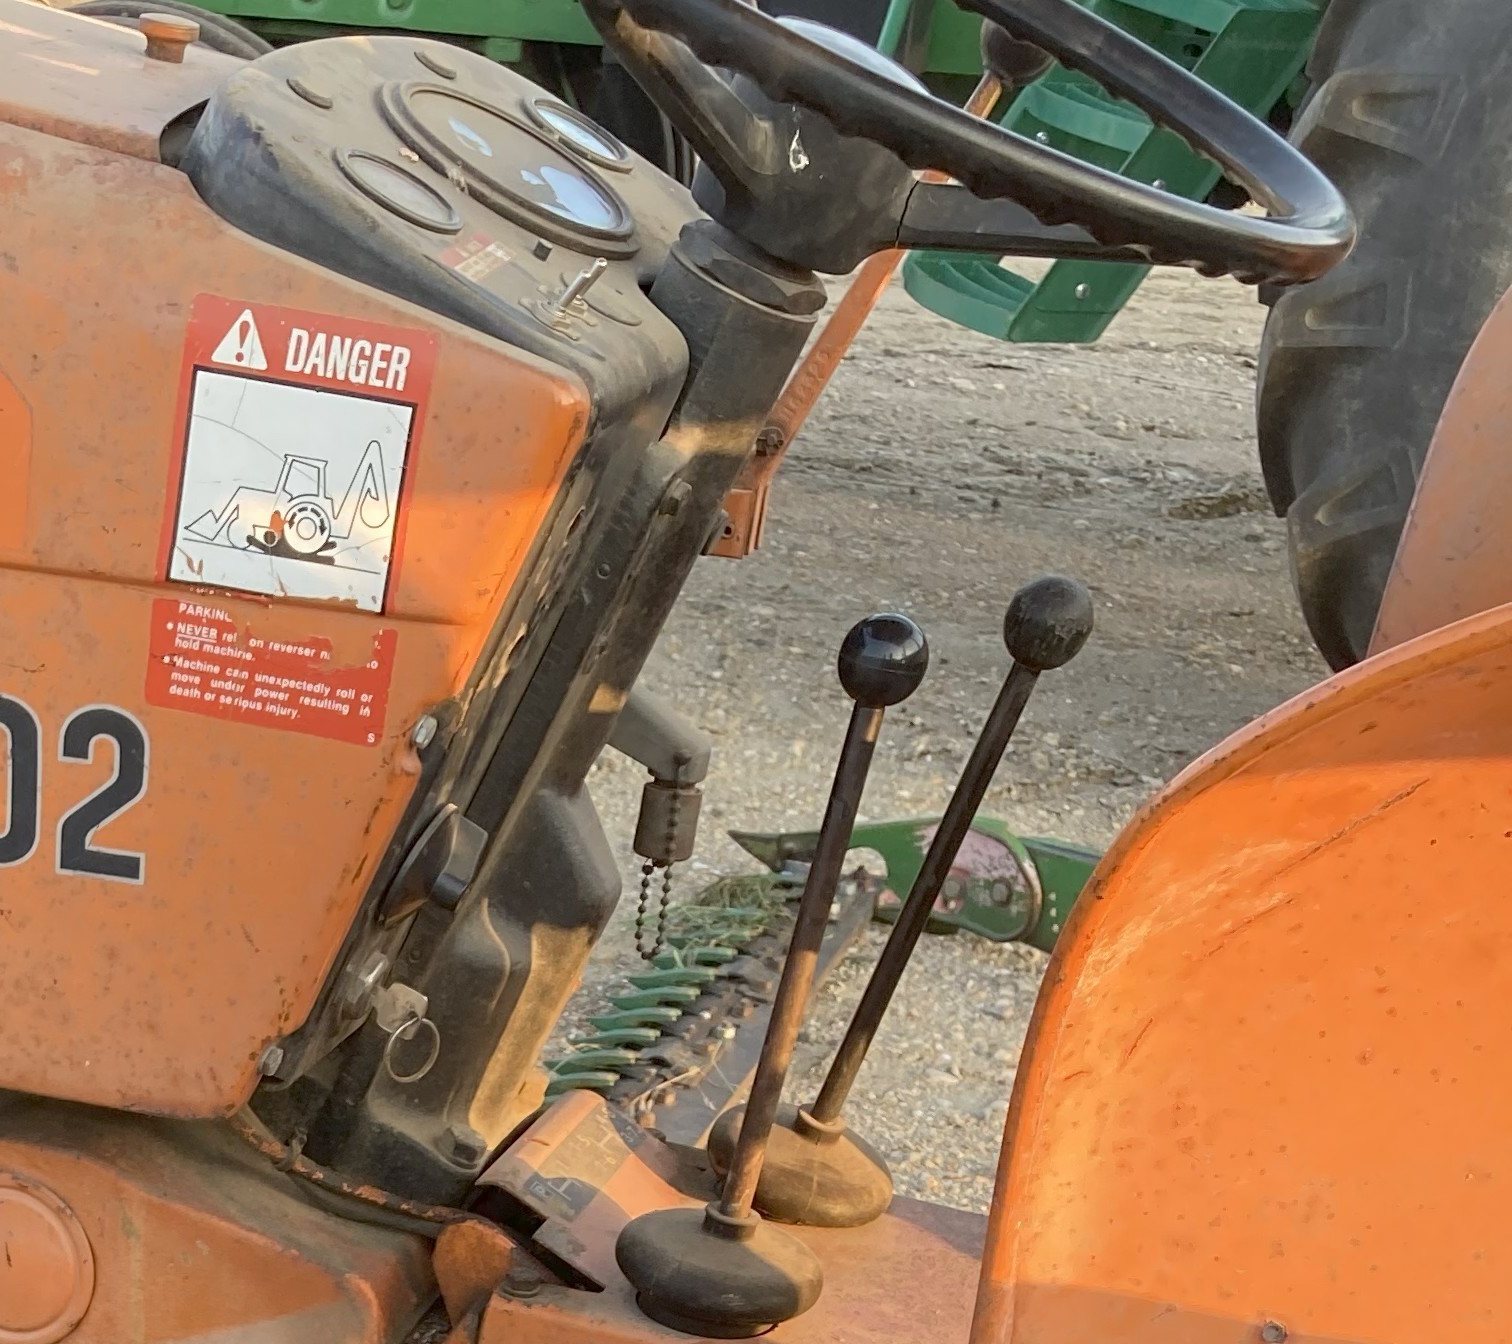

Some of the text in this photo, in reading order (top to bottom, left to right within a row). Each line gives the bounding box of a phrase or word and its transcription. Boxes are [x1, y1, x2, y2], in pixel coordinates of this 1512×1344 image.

[285, 328, 411, 391] DANGER
[174, 637, 200, 651] hold
[177, 622, 218, 642] NEVER
[249, 638, 264, 648] on
[268, 641, 316, 657] reverser
[170, 671, 370, 717] move under power resulting in
[173, 656, 373, 703] Machine can unexpectedly roll or
[169, 684, 201, 699] death
[203, 692, 216, 701] or
[265, 701, 301, 720] injury.
